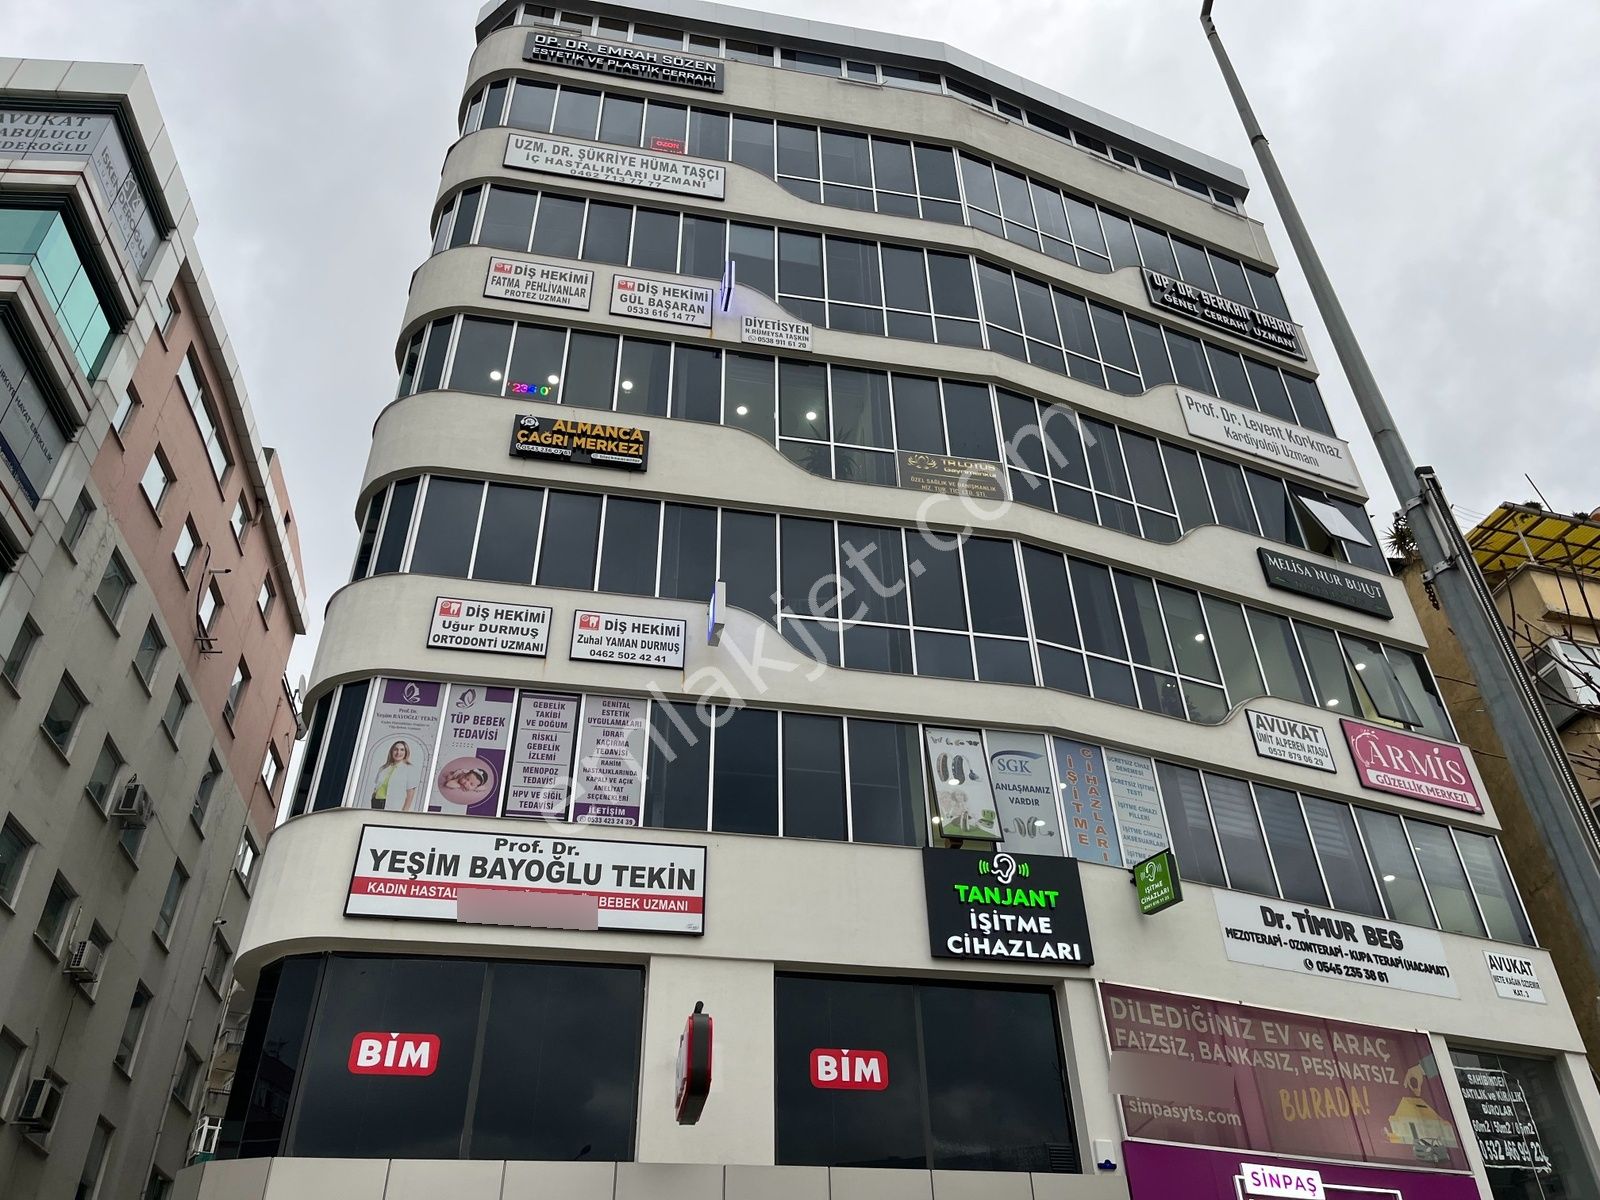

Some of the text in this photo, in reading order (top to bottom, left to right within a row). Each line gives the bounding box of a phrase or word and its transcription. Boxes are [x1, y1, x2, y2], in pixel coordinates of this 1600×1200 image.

[535, 35, 717, 71] OP. DR. EMRAH SÖZEN
[533, 47, 716, 82] ESTETİK VE PLASTİK CERRAHİ
[515, 138, 719, 182] UZM. DR. ŞÜKRİYE HÜMA TAŞÇI
[545, 157, 706, 189] HASTALIKLARI UZMANI
[570, 169, 599, 179] 0462
[514, 265, 588, 285] DİŞ HEKİMİ
[491, 275, 586, 298] FATMA PEHLİVANLAR
[504, 289, 571, 305] PROTEZ UZMANI
[637, 282, 709, 303] DİŞ HEKİMİ
[620, 292, 705, 315] GÜL BAŞARAN
[627, 305, 696, 322] 0533 616 14 77
[745, 316, 809, 336] DİYETİSYEN
[1164, 294, 1296, 349] GENEL CERRAHİ UZMANI
[552, 419, 644, 442] ALMANCA
[1185, 395, 1342, 459] Prof. Dr. Levent Korkmaz
[516, 430, 644, 456] ÇAĞRI MERKEZİ
[1224, 426, 1320, 468] Kardiyoloji Uzmanı
[1265, 553, 1312, 578] MELİSA
[1311, 566, 1344, 588] NUR
[1345, 579, 1382, 599] BULUT
[466, 606, 546, 625] DİŞ HEKİMİ
[442, 619, 539, 639] Uğur DURMUŞ
[604, 620, 681, 638] DİŞ HEKİMİ
[432, 633, 544, 653] ORTODONTİ UZMANI
[577, 633, 680, 655] Zuhal YAMAN DURMUŞ
[589, 649, 667, 662] 0462 502 42 41
[533, 701, 566, 711] GEBELİK
[535, 709, 561, 719] TAKİBİ
[601, 709, 630, 718] ESTETİK
[602, 699, 631, 709] GENİTAL
[450, 712, 506, 728] TÜP BEBEK
[526, 719, 568, 729] VE DOĞUM
[588, 717, 642, 728] UYGULAMALARI
[1255, 714, 1319, 744] AVUKAT
[453, 728, 499, 741] TEDAVİSİ
[532, 733, 558, 742] RİSKLİ
[1275, 737, 1306, 753] ALPEREN
[527, 743, 560, 752] GEBELİK
[528, 752, 556, 761] İZLEMİ
[1268, 747, 1286, 757] 0537
[522, 766, 559, 776] MENOPOZ
[997, 758, 1032, 775] SGK
[1369, 740, 1466, 786] ARMİS
[523, 776, 556, 785] TEDAVİSİ
[995, 782, 1051, 795] ANLAŞMAMIZ
[1375, 773, 1469, 804] GÜZELLİK MERKEZİ
[512, 790, 541, 799] HPV VE
[1008, 796, 1040, 807] VARDIR
[588, 806, 626, 817] İLETİŞİM
[494, 837, 580, 856] Prof. Dr.
[369, 847, 696, 891] YEŞİM BAYOĞLU TEKİN
[366, 881, 689, 912] KADIN BEBEK UZMANI
[954, 884, 1059, 908] TANJANT
[970, 908, 1053, 935] İŞİTME
[1259, 905, 1404, 951] Dr. TİMUR BEG
[947, 933, 1081, 961] CİHAZLARI
[1225, 927, 1284, 948] MEZOTERAPİ
[1289, 939, 1344, 958] OZONTERAPİ
[1349, 949, 1374, 964] KUPA
[1316, 960, 1343, 975] 0545
[1343, 965, 1363, 979] 235
[1363, 969, 1377, 981] 38
[1488, 955, 1533, 977] AVUKAT
[1110, 996, 1392, 1062] DİLEDİĞİNİZ EV ve ARAÇ
[357, 1033, 430, 1068] BİM
[1115, 1028, 1400, 1086] FAİZSİZ, BANKASIZ, PEŞİNATSIZ
[817, 1049, 881, 1083] BİM
[1129, 1096, 1242, 1128] sinpasyts.com
[1278, 1086, 1371, 1122] BURADA!
[1251, 1167, 1317, 1197] SİNPAŞ
